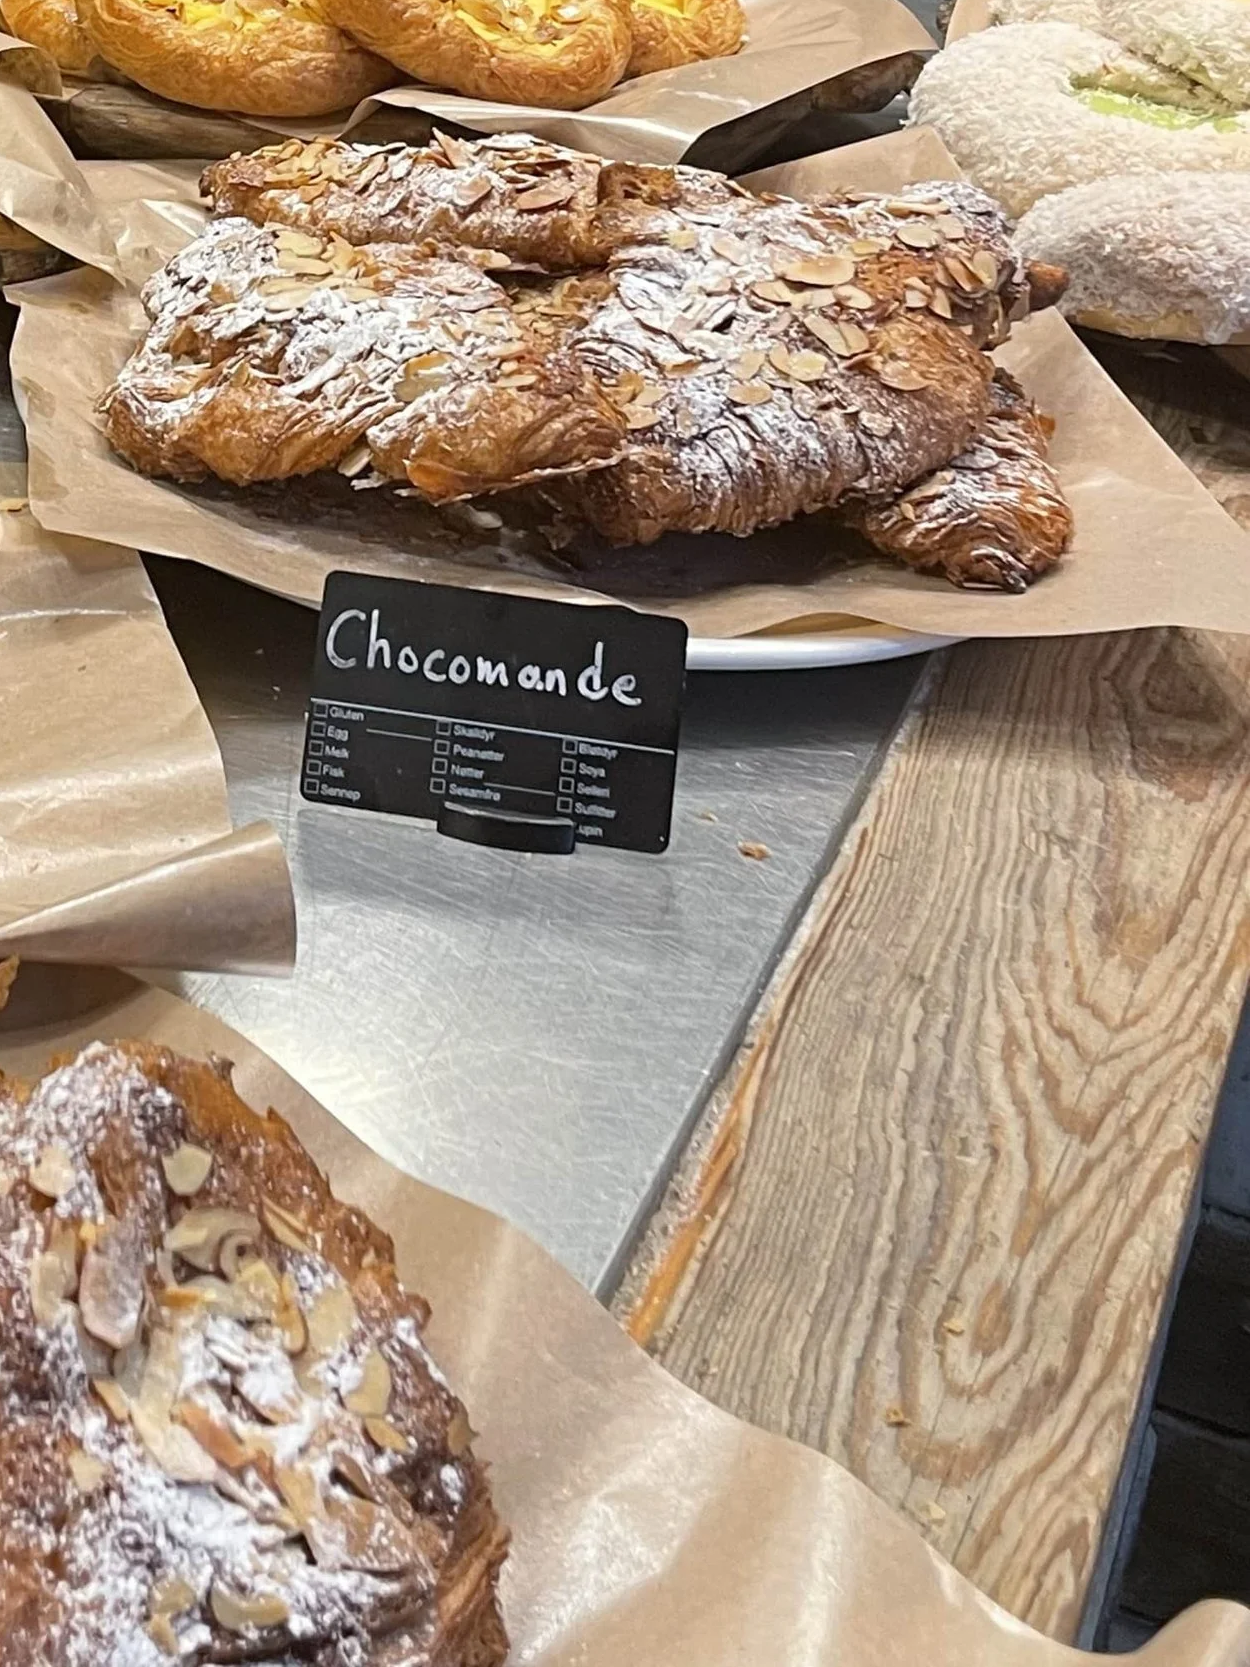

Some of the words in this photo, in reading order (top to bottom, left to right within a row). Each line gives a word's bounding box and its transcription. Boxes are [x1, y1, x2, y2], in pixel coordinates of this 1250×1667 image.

[326, 608, 642, 706] Chocomande
[329, 707, 364, 721] Gluten
[326, 726, 349, 741] Egg
[324, 745, 350, 758] Melk
[322, 764, 345, 778] Fisk
[578, 763, 606, 778] Soya
[320, 784, 361, 802] Sennep
